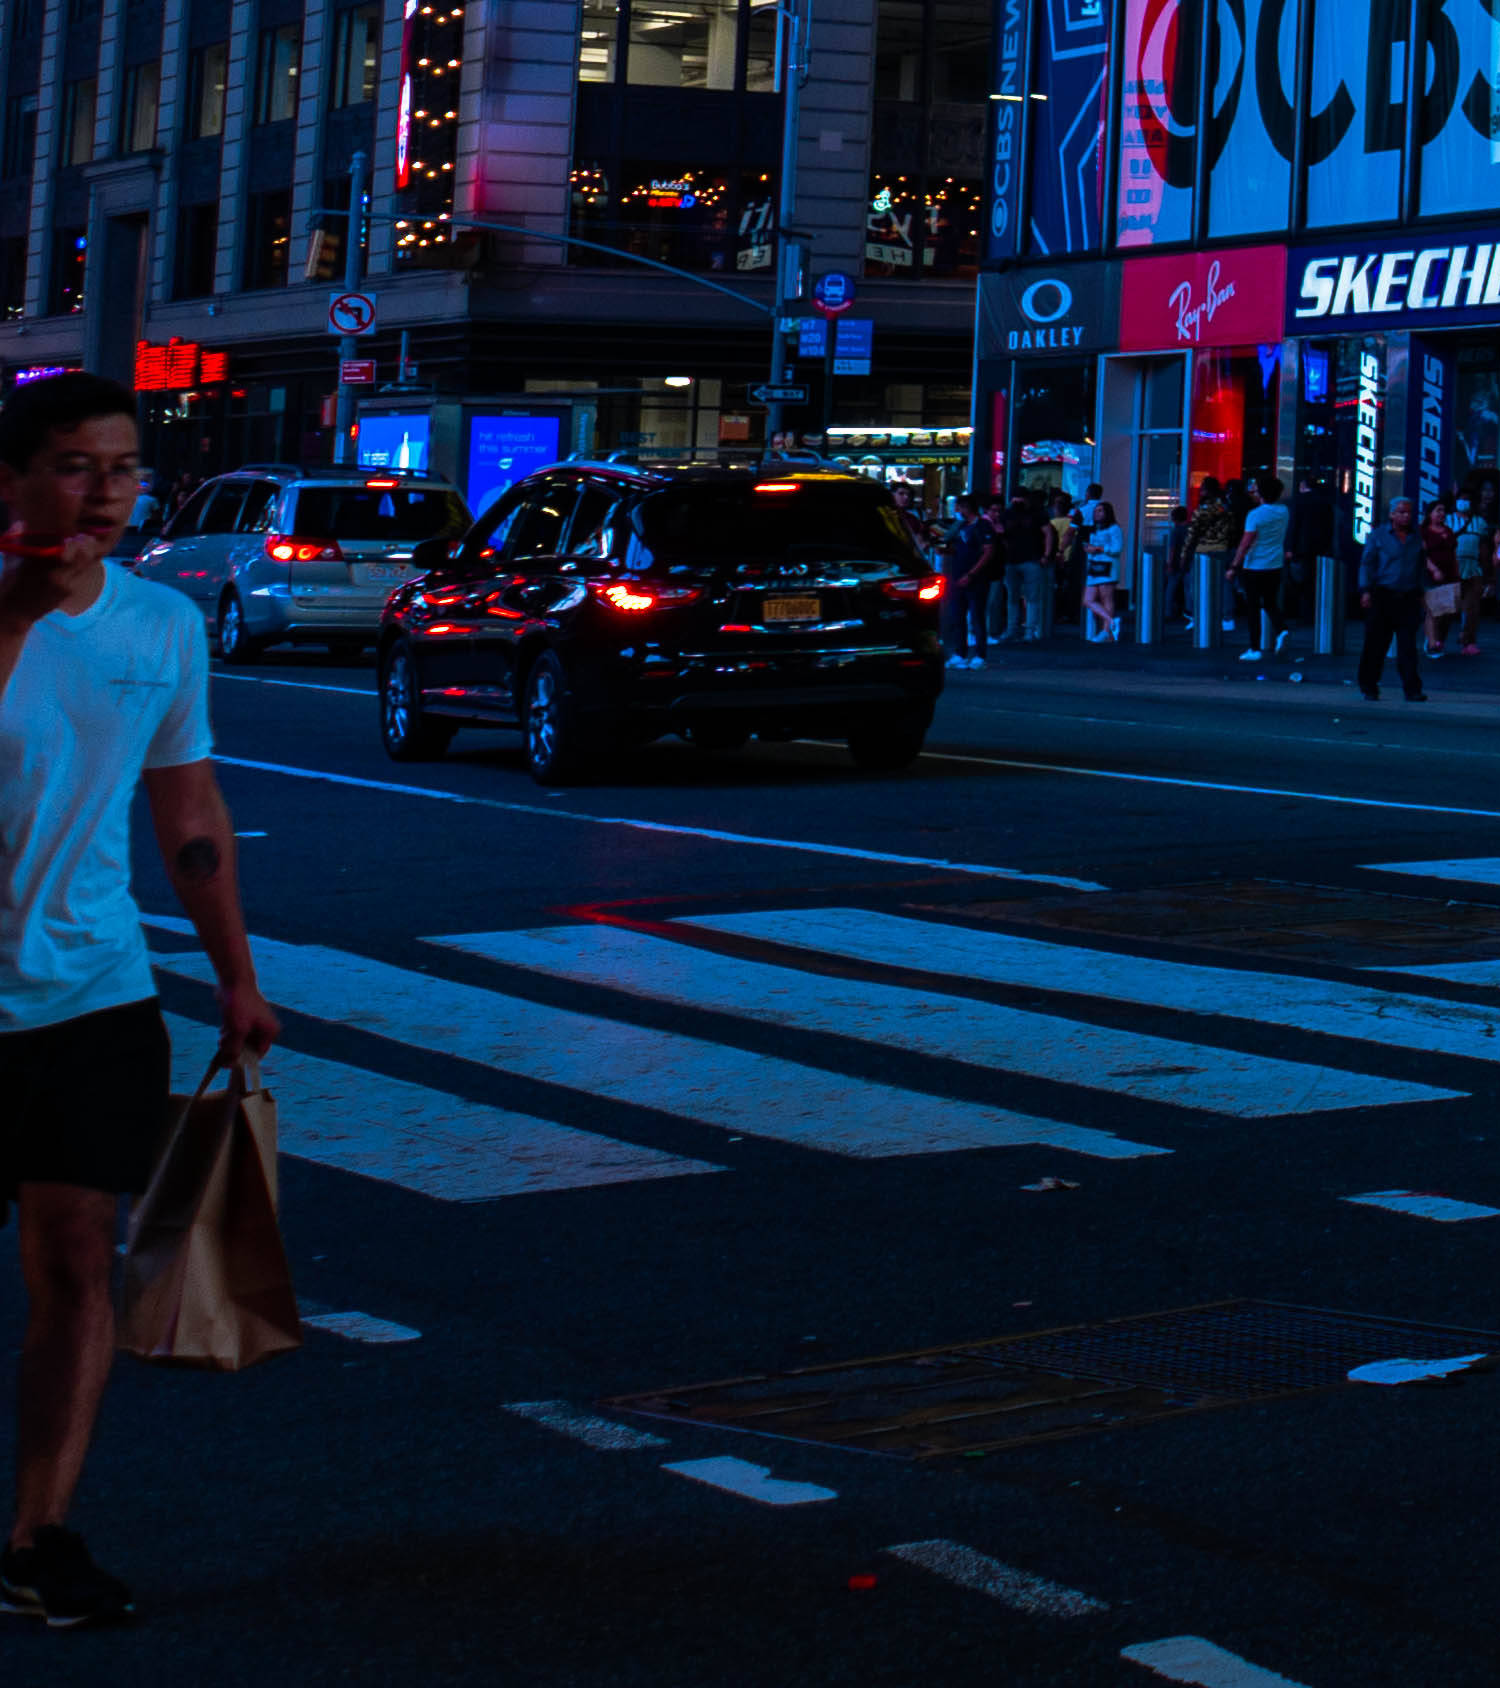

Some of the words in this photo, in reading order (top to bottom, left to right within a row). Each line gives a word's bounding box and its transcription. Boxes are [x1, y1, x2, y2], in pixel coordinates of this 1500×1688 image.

[993, 107, 1014, 196] CBS
[1007, 327, 1084, 350] OAKLEY
[1353, 350, 1382, 544] SKECHERS
